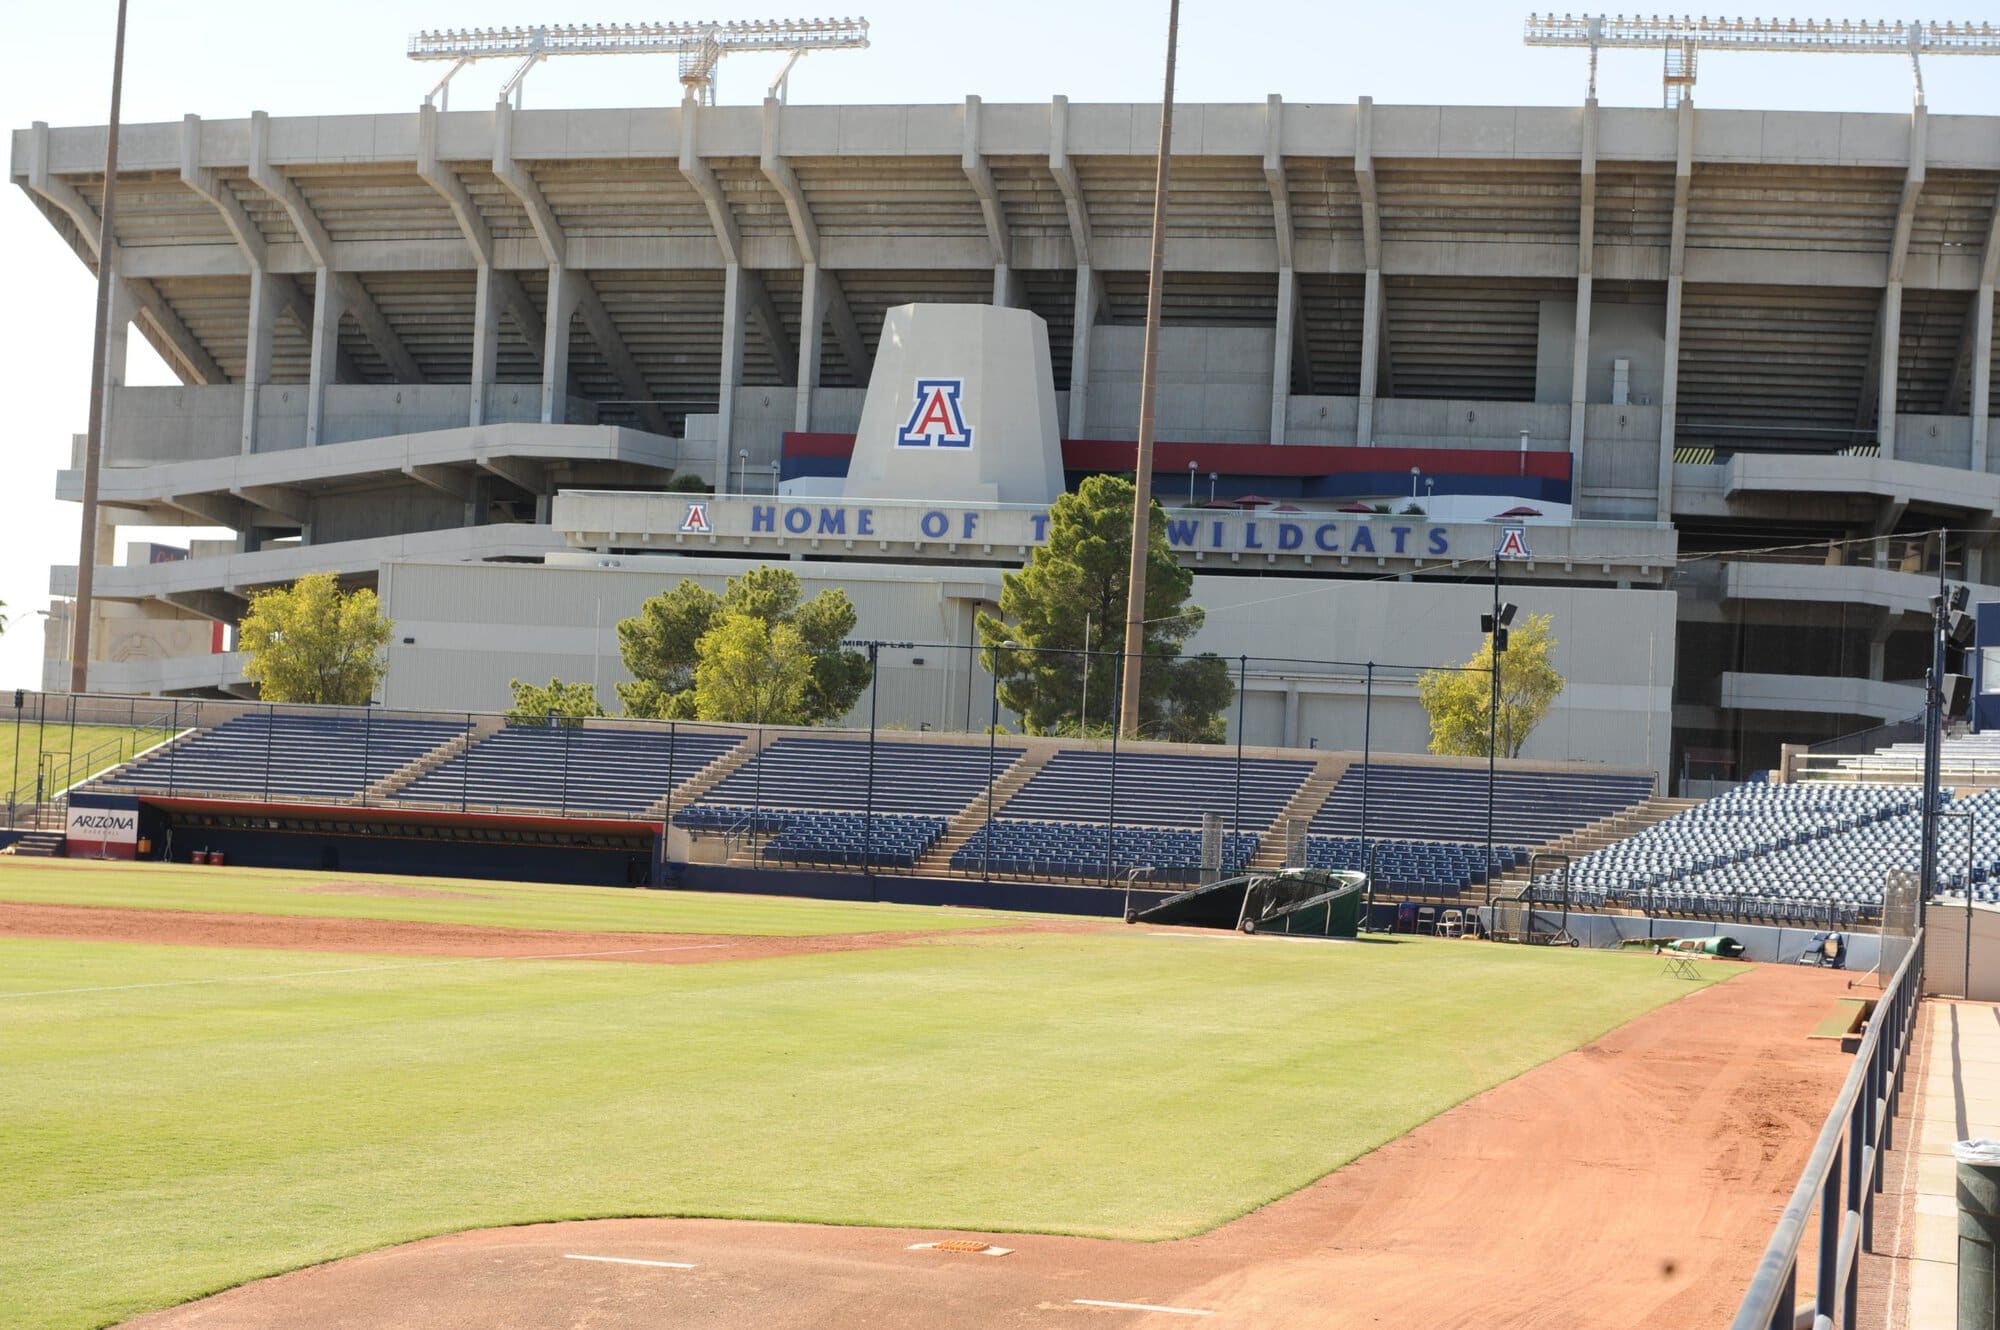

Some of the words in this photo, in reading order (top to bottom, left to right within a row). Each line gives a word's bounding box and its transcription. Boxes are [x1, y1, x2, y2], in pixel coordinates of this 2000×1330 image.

[896, 379, 973, 449] A
[679, 501, 713, 534] A
[751, 505, 874, 535] HOME
[921, 511, 979, 539] OF
[1167, 519, 1449, 555] WILDCATS
[1494, 527, 1532, 560] A
[842, 640, 887, 649] MIRRR
[72, 815, 134, 830] ARIZONA
